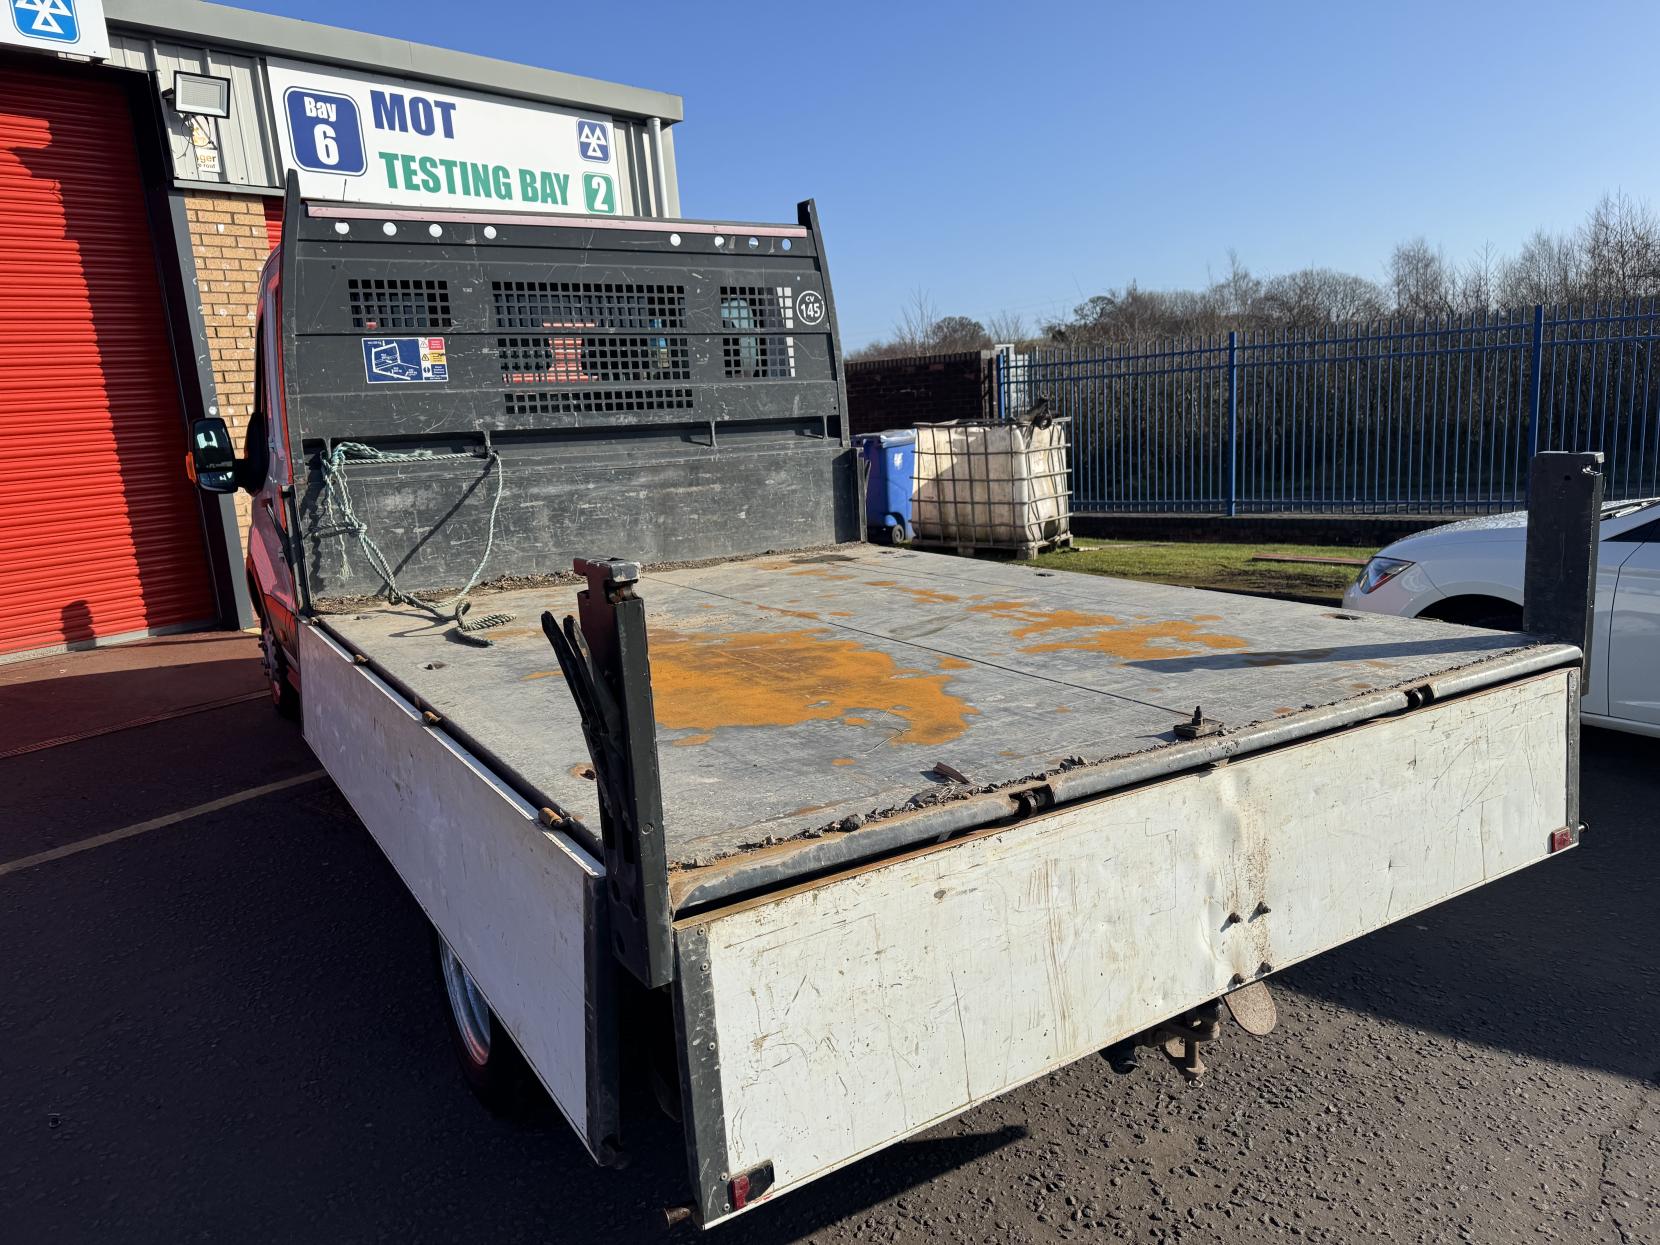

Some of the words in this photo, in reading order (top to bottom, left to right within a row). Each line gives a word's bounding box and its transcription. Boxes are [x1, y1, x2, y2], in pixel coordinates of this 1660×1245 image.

[303, 96, 337, 122] Bay
[370, 89, 457, 139] MOT
[197, 154, 216, 163] ger
[313, 123, 340, 166] 6
[378, 151, 513, 200] TESTING
[518, 168, 570, 206] BAY
[591, 176, 609, 212] 2
[800, 303, 821, 318] 145
